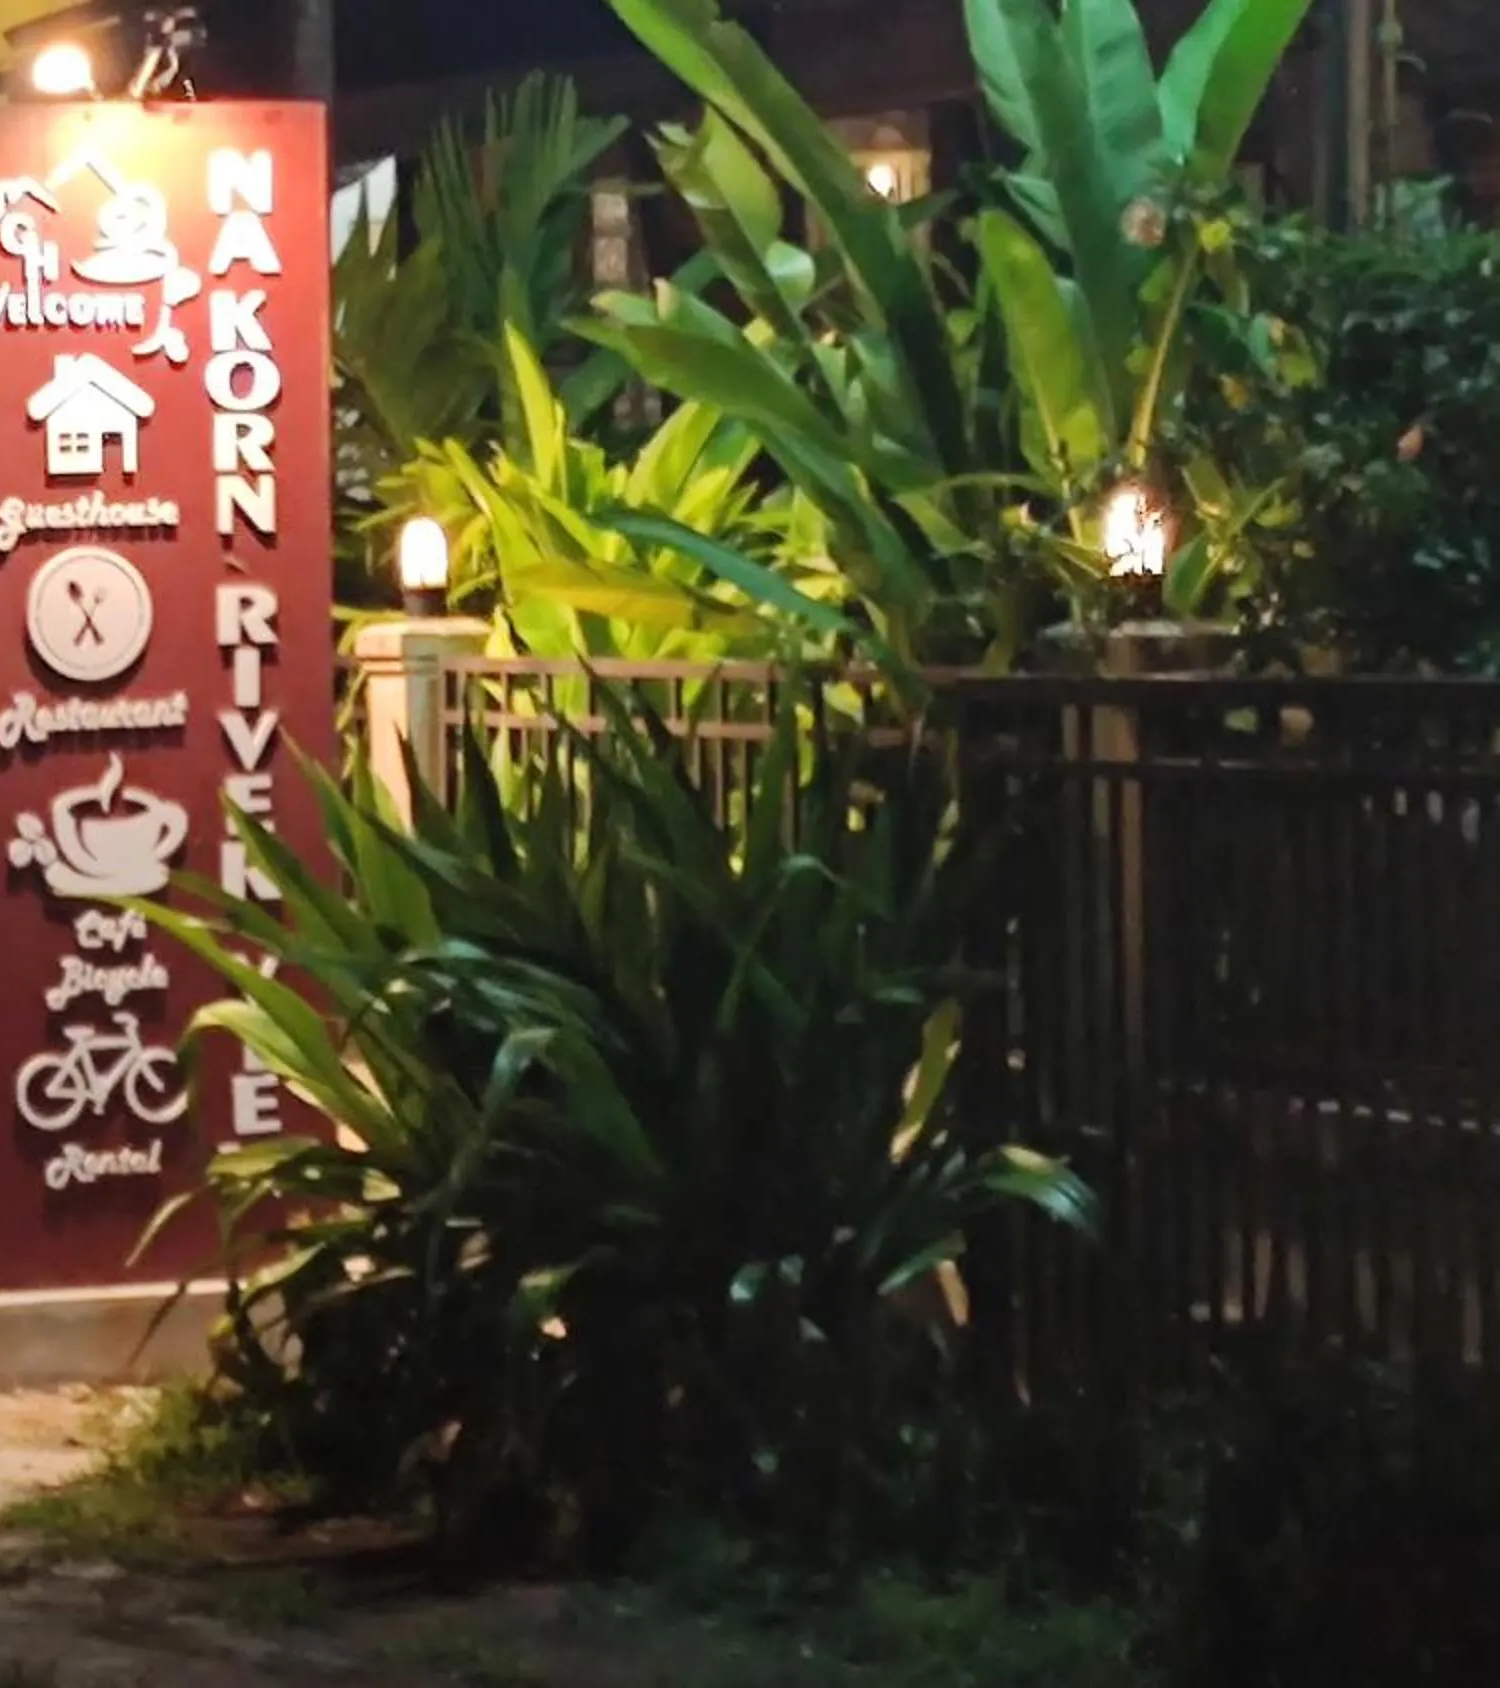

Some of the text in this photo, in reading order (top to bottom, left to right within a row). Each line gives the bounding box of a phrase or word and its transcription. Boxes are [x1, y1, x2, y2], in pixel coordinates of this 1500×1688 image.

[204, 148, 282, 534] NAKORN
[45, 953, 169, 1010] Bicycle
[45, 1139, 162, 1189] Rental
